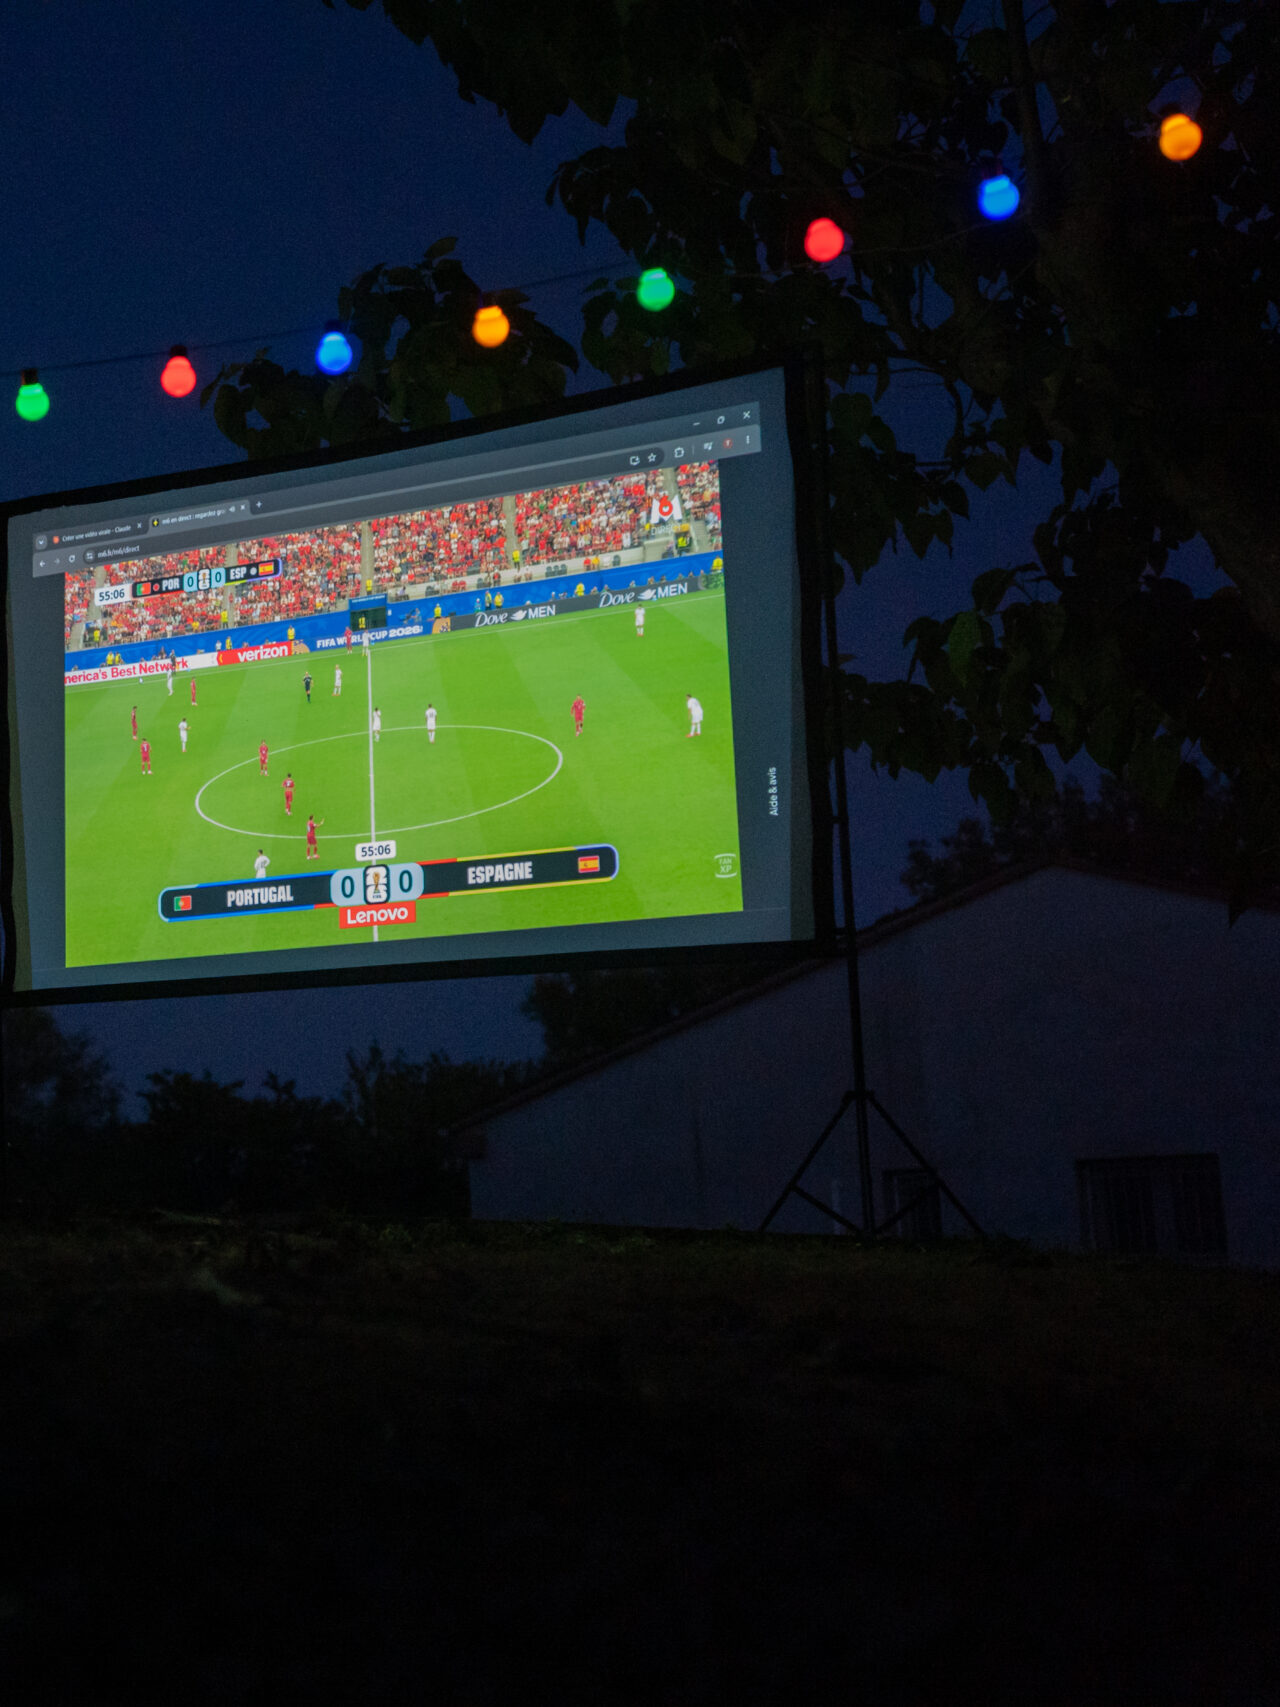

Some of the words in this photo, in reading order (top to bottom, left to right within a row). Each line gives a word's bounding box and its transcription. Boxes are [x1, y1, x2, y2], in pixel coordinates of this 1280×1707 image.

[178, 514, 192, 522] direct
[195, 510, 216, 520] regardez
[115, 525, 131, 533] Claude
[99, 590, 125, 602] 55:06
[162, 577, 180, 591] POR
[187, 576, 194, 588] 0
[215, 571, 222, 583] 0
[230, 567, 247, 580] ESP
[599, 591, 635, 608] Dove
[658, 582, 688, 599] MEN
[474, 612, 508, 628] Dove
[528, 605, 556, 620] MEN
[316, 638, 336, 648] FIFA
[370, 630, 388, 641] CUP
[389, 625, 421, 638] 2026
[237, 644, 289, 663] verizon
[111, 662, 136, 677] Best
[767, 767, 777, 785] avis
[768, 786, 778, 794] &
[769, 795, 779, 816] Aide
[361, 844, 391, 857] 55:06
[720, 865, 732, 873] XP
[227, 885, 294, 907] PORTUGAL
[341, 875, 355, 898] 0
[399, 870, 413, 893] 0
[467, 861, 533, 885] ESPAGNE
[347, 906, 408, 925] Lenovo
